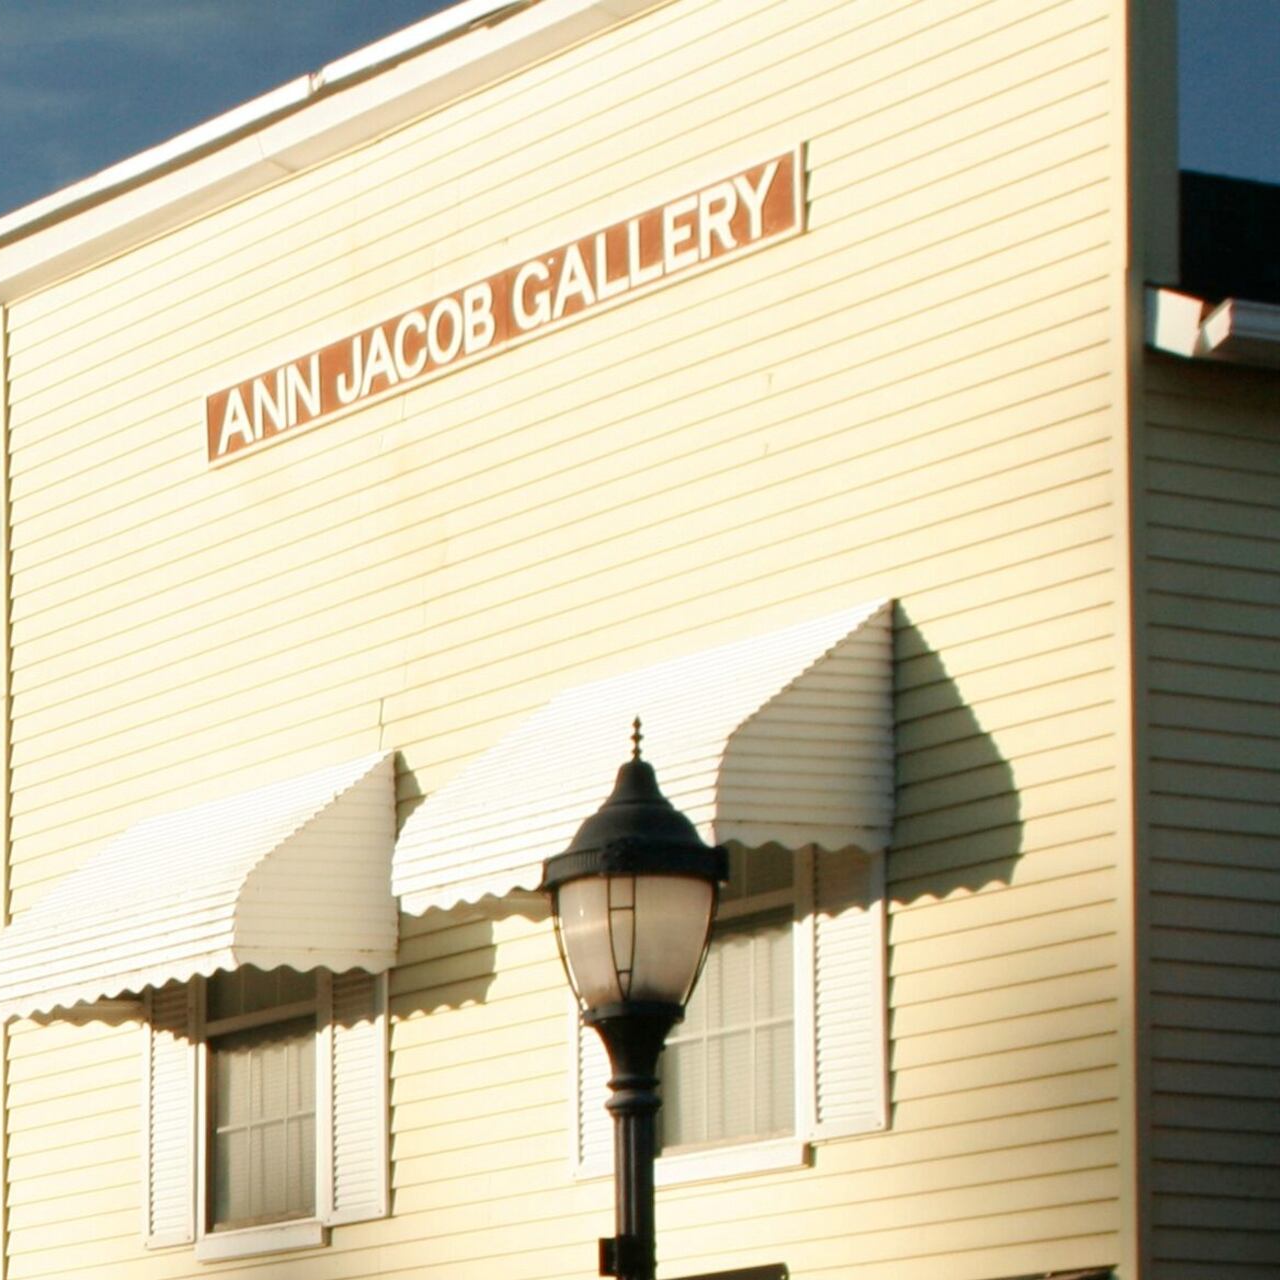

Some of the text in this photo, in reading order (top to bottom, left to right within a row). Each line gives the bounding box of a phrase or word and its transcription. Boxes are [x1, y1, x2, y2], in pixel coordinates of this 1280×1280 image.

[216, 159, 783, 455] ANN JACOB GALLERY
